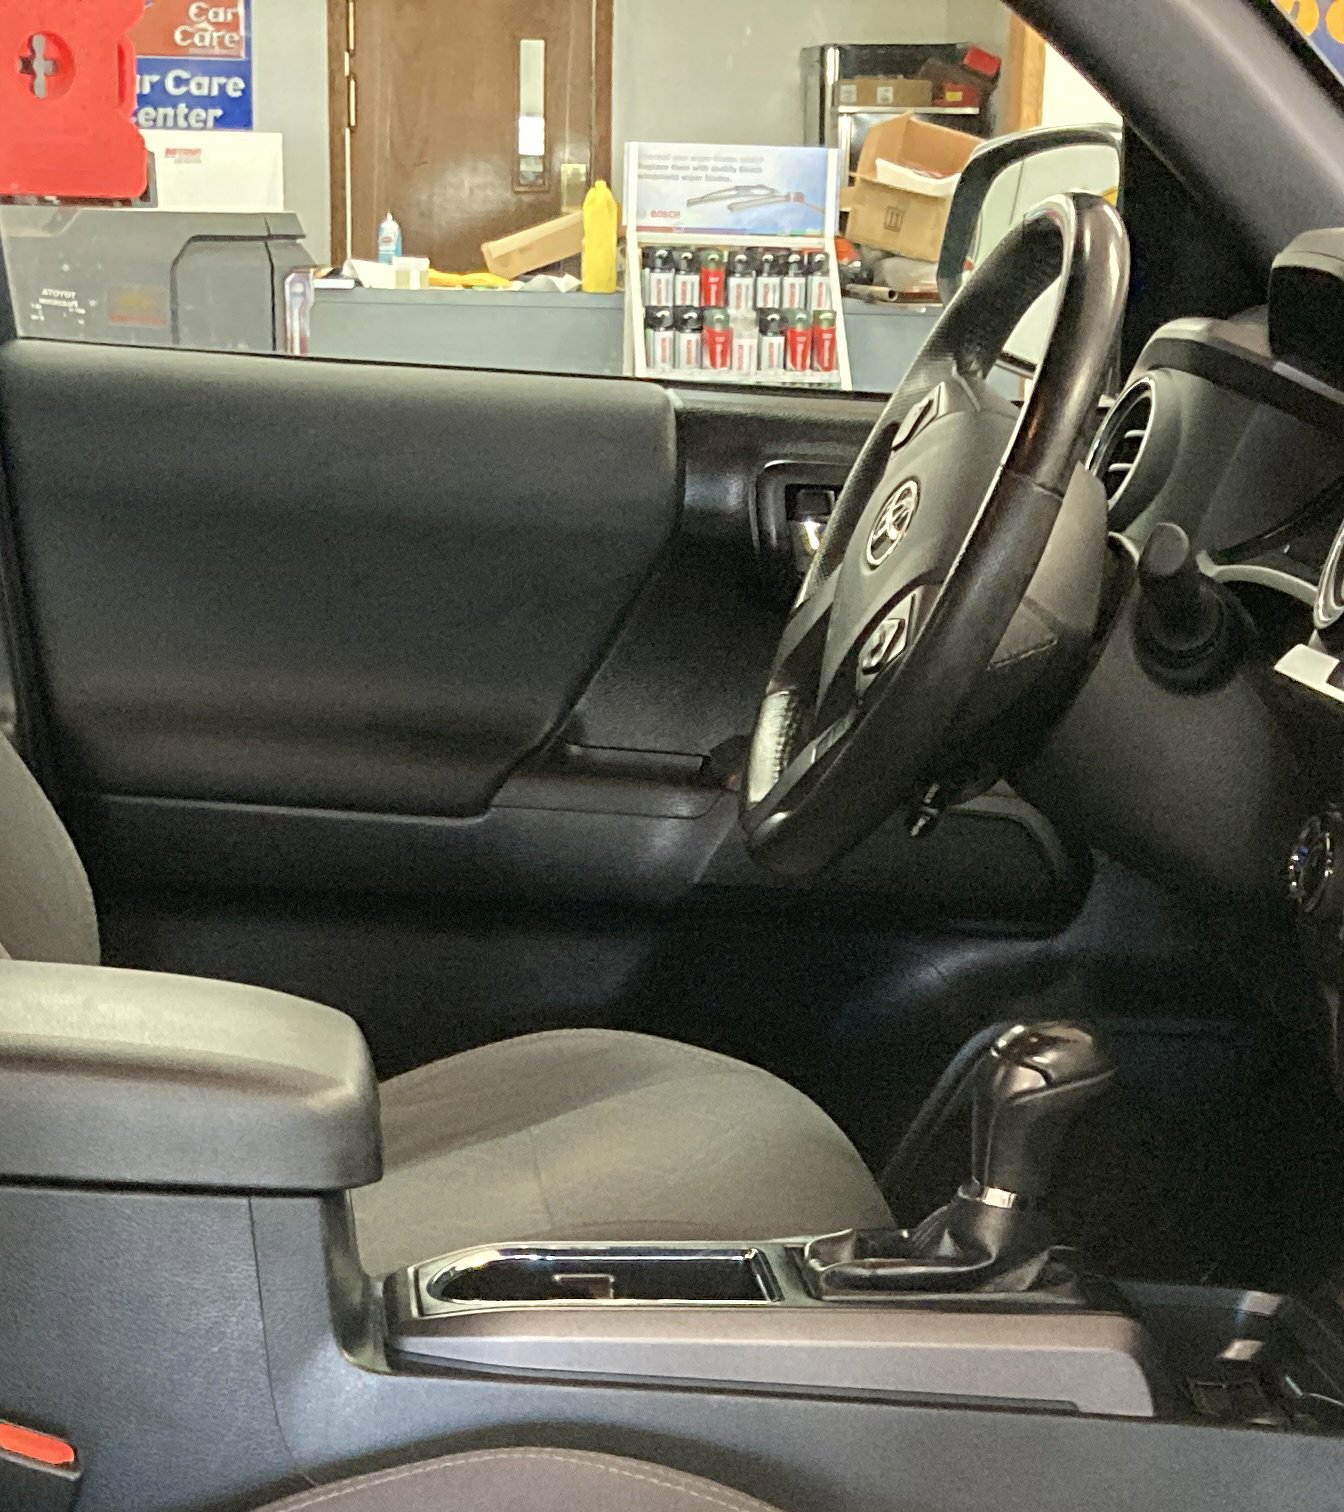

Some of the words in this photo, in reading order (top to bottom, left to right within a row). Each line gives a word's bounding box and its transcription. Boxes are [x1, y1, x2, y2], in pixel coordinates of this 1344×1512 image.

[188, 1, 241, 23] Car
[173, 25, 241, 47] Care
[164, 68, 246, 98] Care
[130, 103, 223, 129] enter
